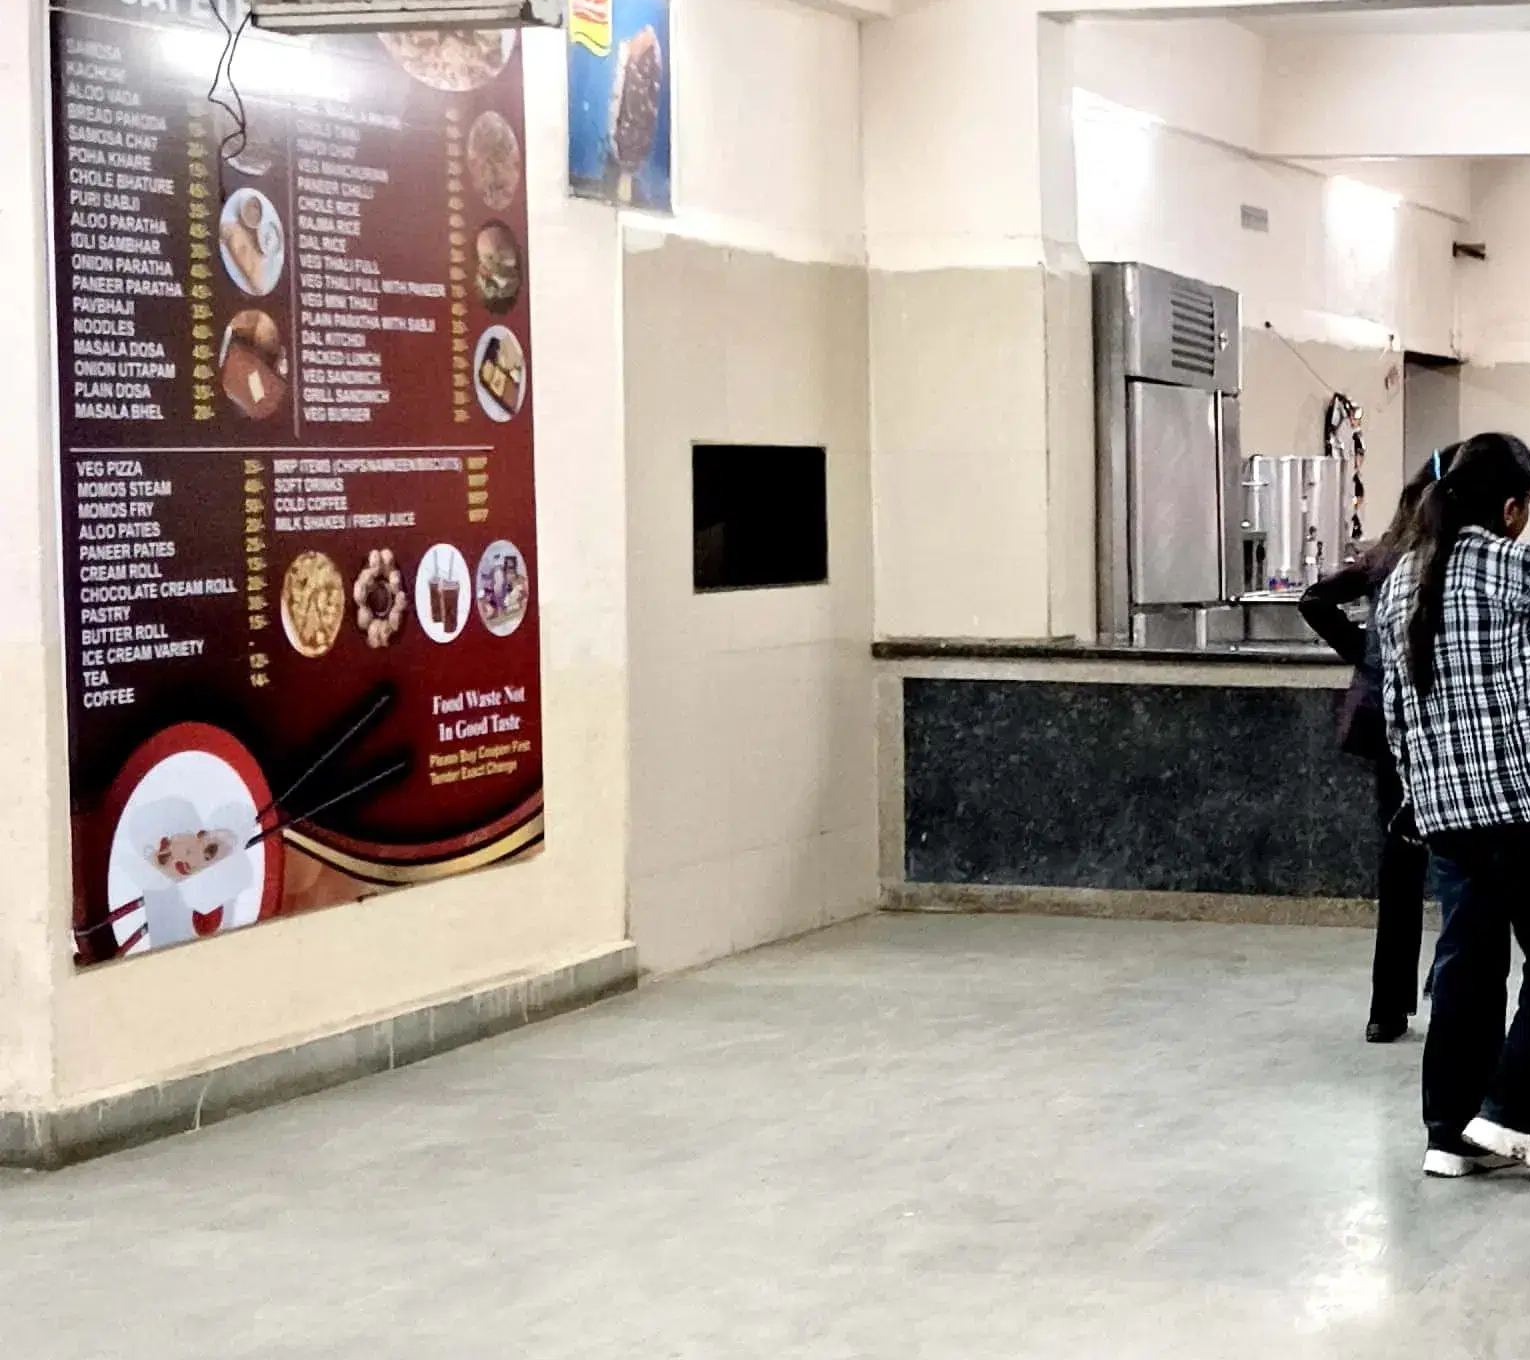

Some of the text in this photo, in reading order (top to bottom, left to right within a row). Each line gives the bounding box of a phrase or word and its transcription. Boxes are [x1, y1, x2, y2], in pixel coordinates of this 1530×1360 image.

[67, 103, 112, 124] BREAD
[68, 125, 122, 146] SAMOSA
[68, 146, 105, 164] POHA
[70, 168, 175, 195] CHOLE BHATURE
[70, 189, 140, 211] PURI SABJI
[71, 211, 168, 235] ALOO PARATHA
[98, 235, 161, 255] SAMBHAR
[72, 253, 174, 277] ONION PARATHA
[72, 275, 183, 297] PANEER PARATHA
[73, 296, 135, 315] PAVBHAJI
[74, 317, 135, 336] NOODLES
[73, 339, 165, 358] MASALA DOSA
[74, 359, 116, 377] ONION
[118, 362, 176, 379] UTTAPAM
[75, 381, 152, 398] PLAIN DOSA
[75, 403, 164, 420] MASALA BHEL
[77, 460, 143, 476] VEG PIZZA
[78, 480, 172, 498] MOMOS STEAM
[78, 501, 154, 519] MOMOS FRY
[307, 496, 347, 511] COFFEE
[79, 521, 160, 540] ALOO PATIES
[80, 541, 176, 560] PANEER PATIES
[80, 563, 162, 582] CREAM ROLL
[81, 578, 238, 603] CHOCOLATE CREAM ROLL
[81, 606, 131, 624] PASTRY
[82, 623, 168, 645] BUTTER ROLL
[82, 640, 204, 666] ICE CREAM VARIETY
[83, 670, 110, 687] TEA
[83, 687, 135, 708] COFFEE
[432, 685, 525, 715] Food Waste Not
[439, 714, 520, 742] In Good Taste
